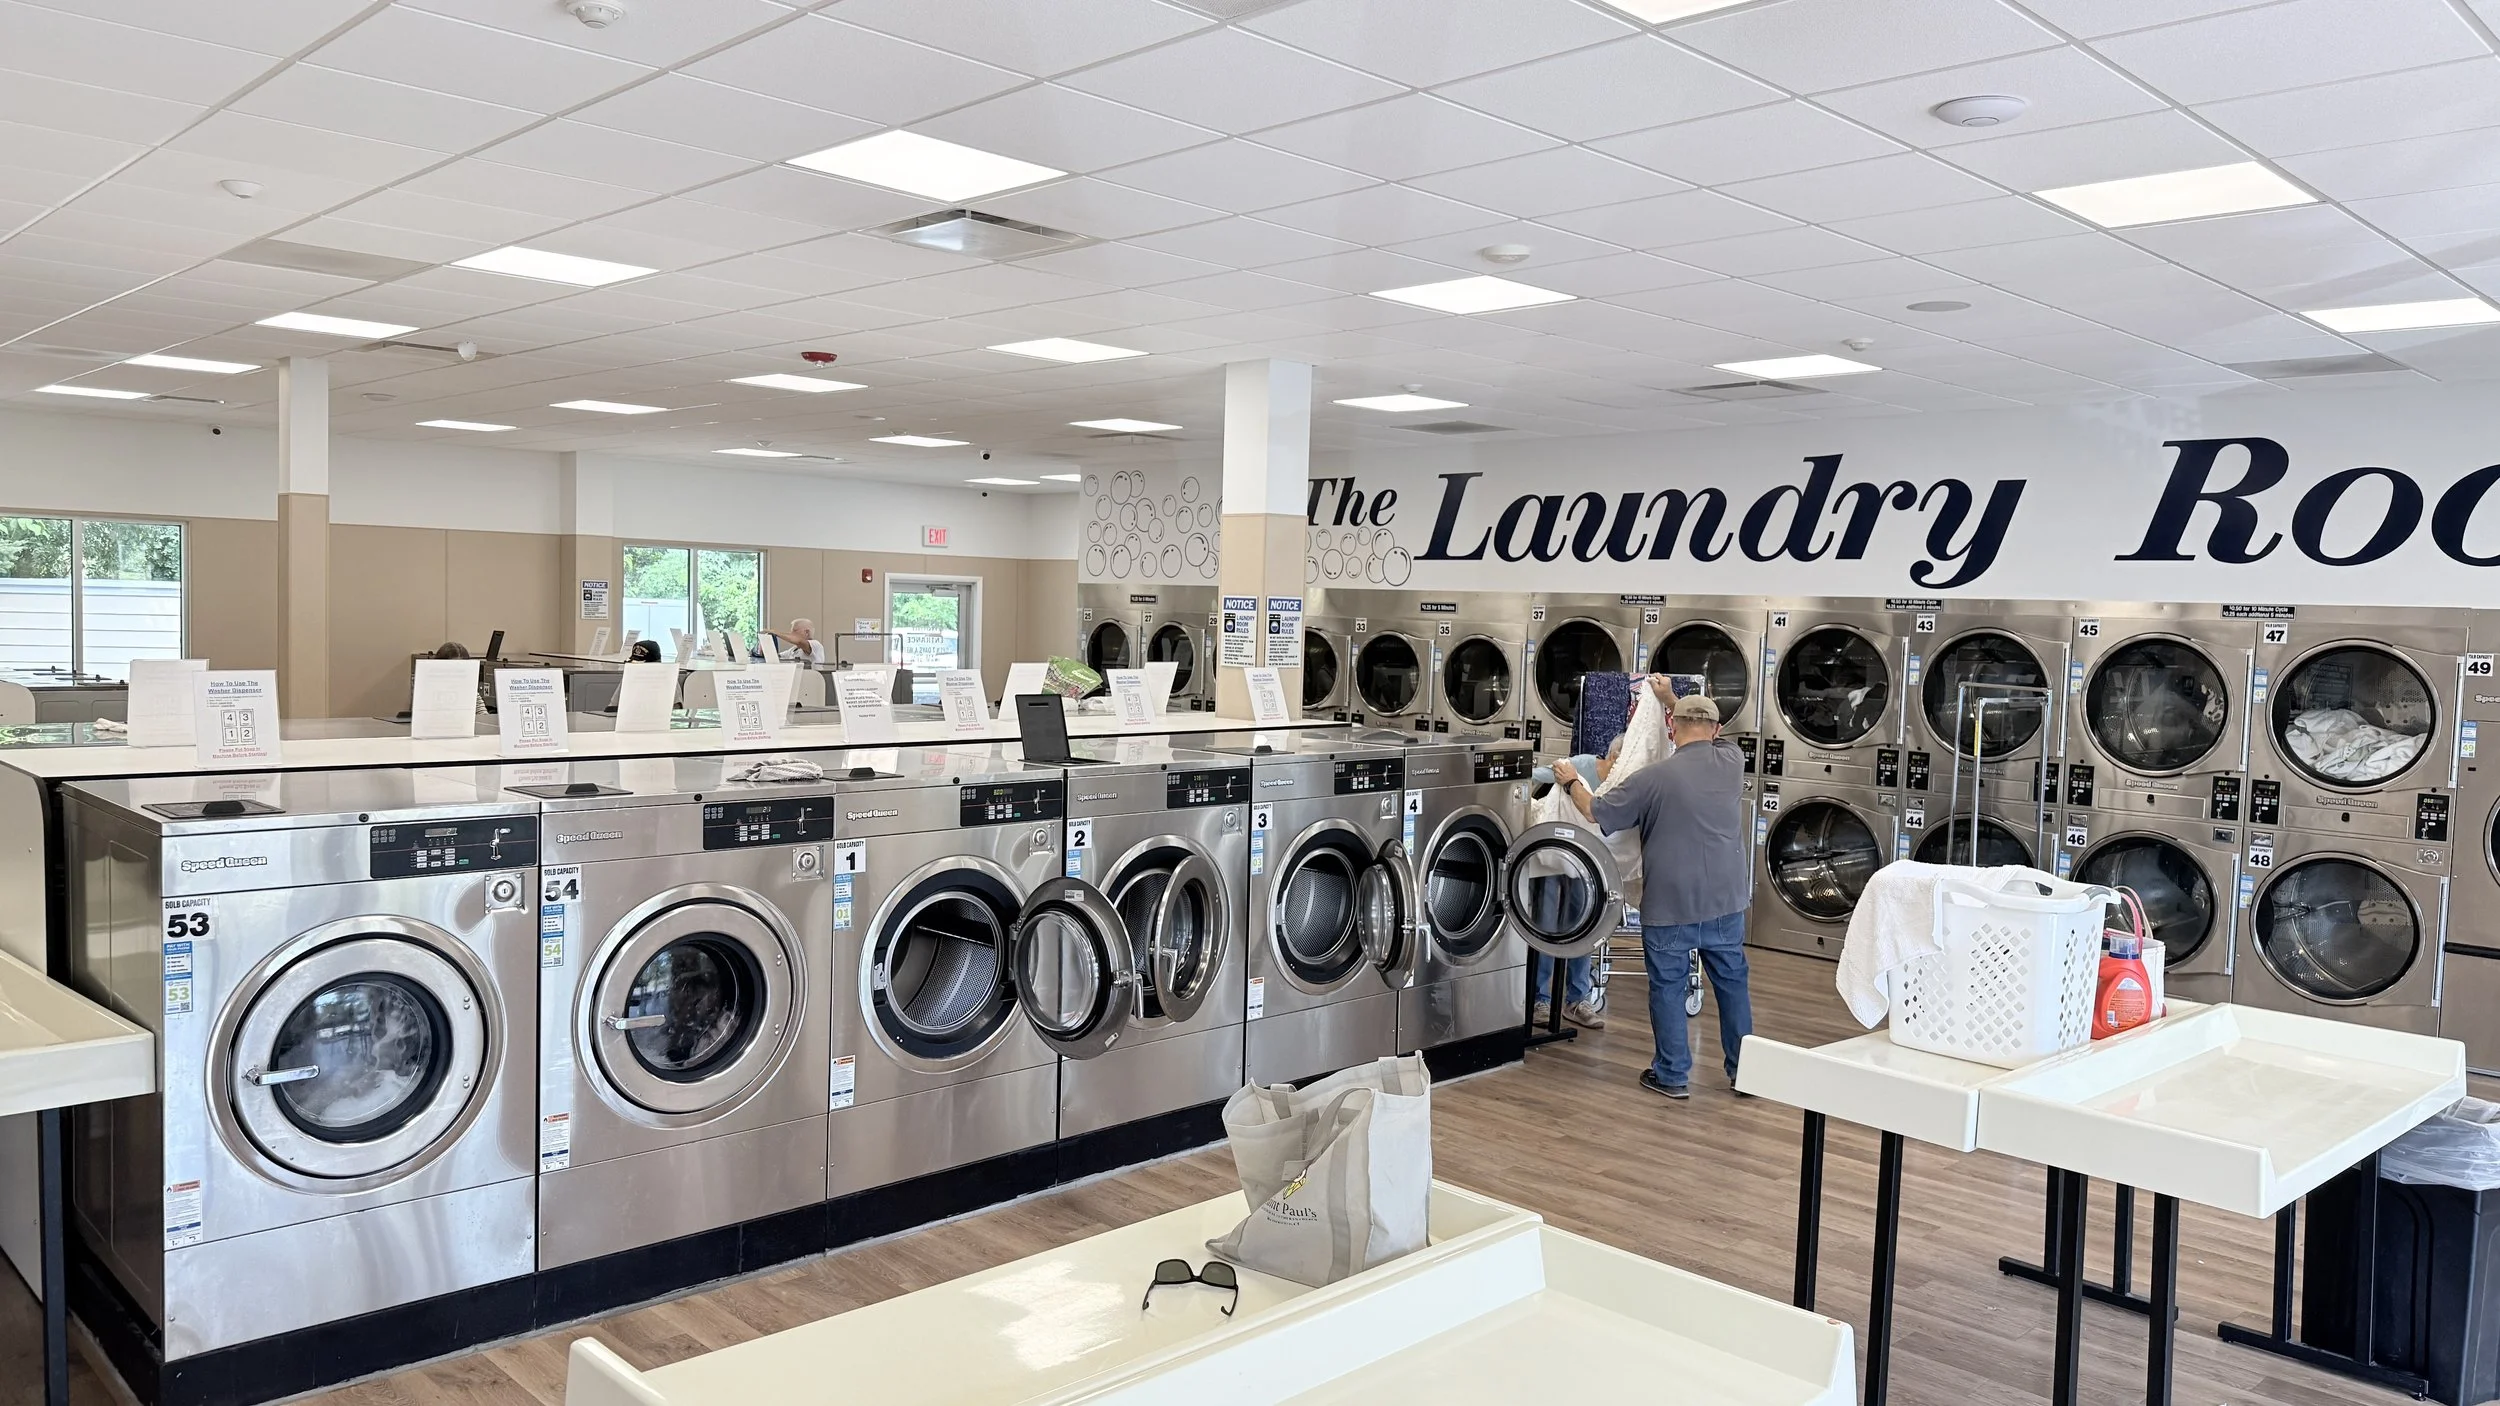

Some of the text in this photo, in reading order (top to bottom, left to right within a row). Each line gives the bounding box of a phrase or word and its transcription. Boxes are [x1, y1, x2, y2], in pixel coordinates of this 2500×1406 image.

[1307, 476, 1398, 526] The
[1411, 454, 2028, 589] Laundry
[928, 528, 947, 545] EXIT
[1226, 600, 1254, 609] NOTICE
[1270, 600, 1299, 610] NOTICE
[1533, 611, 1544, 620] 37
[1646, 614, 1658, 623] 39
[1774, 616, 1786, 627] 41
[1918, 620, 1933, 631] 43
[2080, 625, 2098, 636] 45
[2266, 630, 2285, 642] 47
[2468, 662, 2491, 674] 49
[1410, 799, 1417, 812] 4
[1764, 800, 1778, 810] 42
[2317, 795, 2379, 808] Speed Queen
[846, 809, 898, 821] Speed Queen
[1258, 813, 1267, 828] 3
[1906, 817, 1923, 827] 44
[556, 831, 623, 844] Speed Queen
[1074, 830, 1086, 847] 2
[2068, 834, 2086, 845] 46
[181, 856, 267, 872] Speed Queen
[846, 852, 856, 870] 1
[2250, 854, 2271, 867] 48
[557, 867, 579, 875] CAPACITY
[544, 878, 579, 902] 54
[182, 898, 210, 907] CAPACITY
[167, 912, 210, 938] 53
[544, 944, 561, 956] 54
[168, 987, 190, 1002] 53
[1282, 1203, 1317, 1217] Paul's
